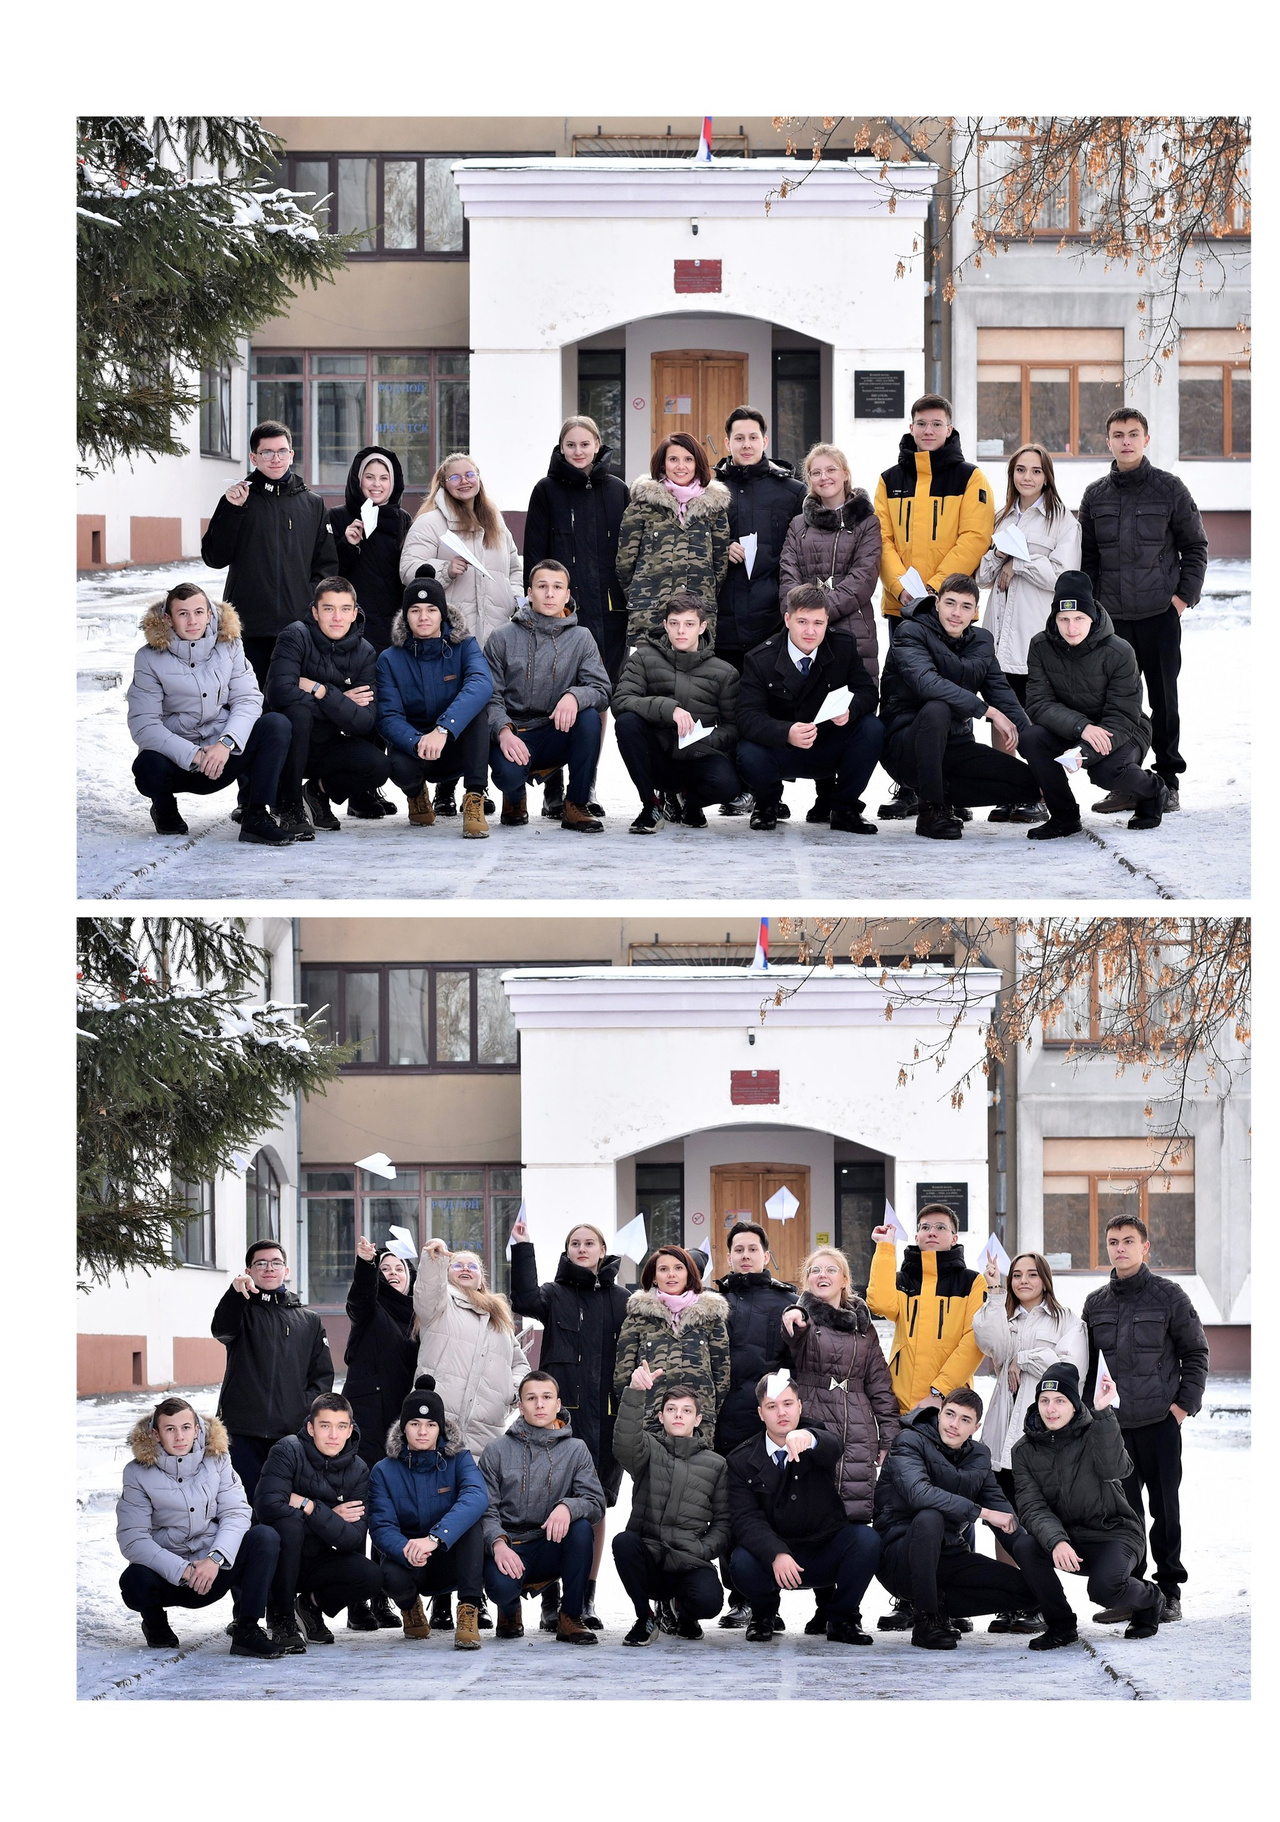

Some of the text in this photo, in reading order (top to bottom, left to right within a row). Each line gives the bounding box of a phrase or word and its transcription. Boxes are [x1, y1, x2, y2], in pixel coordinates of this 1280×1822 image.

[378, 382, 426, 394] РОДНОЙ
[375, 423, 429, 433] ИРКУТСК
[431, 1198, 480, 1211] РОДНОЙ
